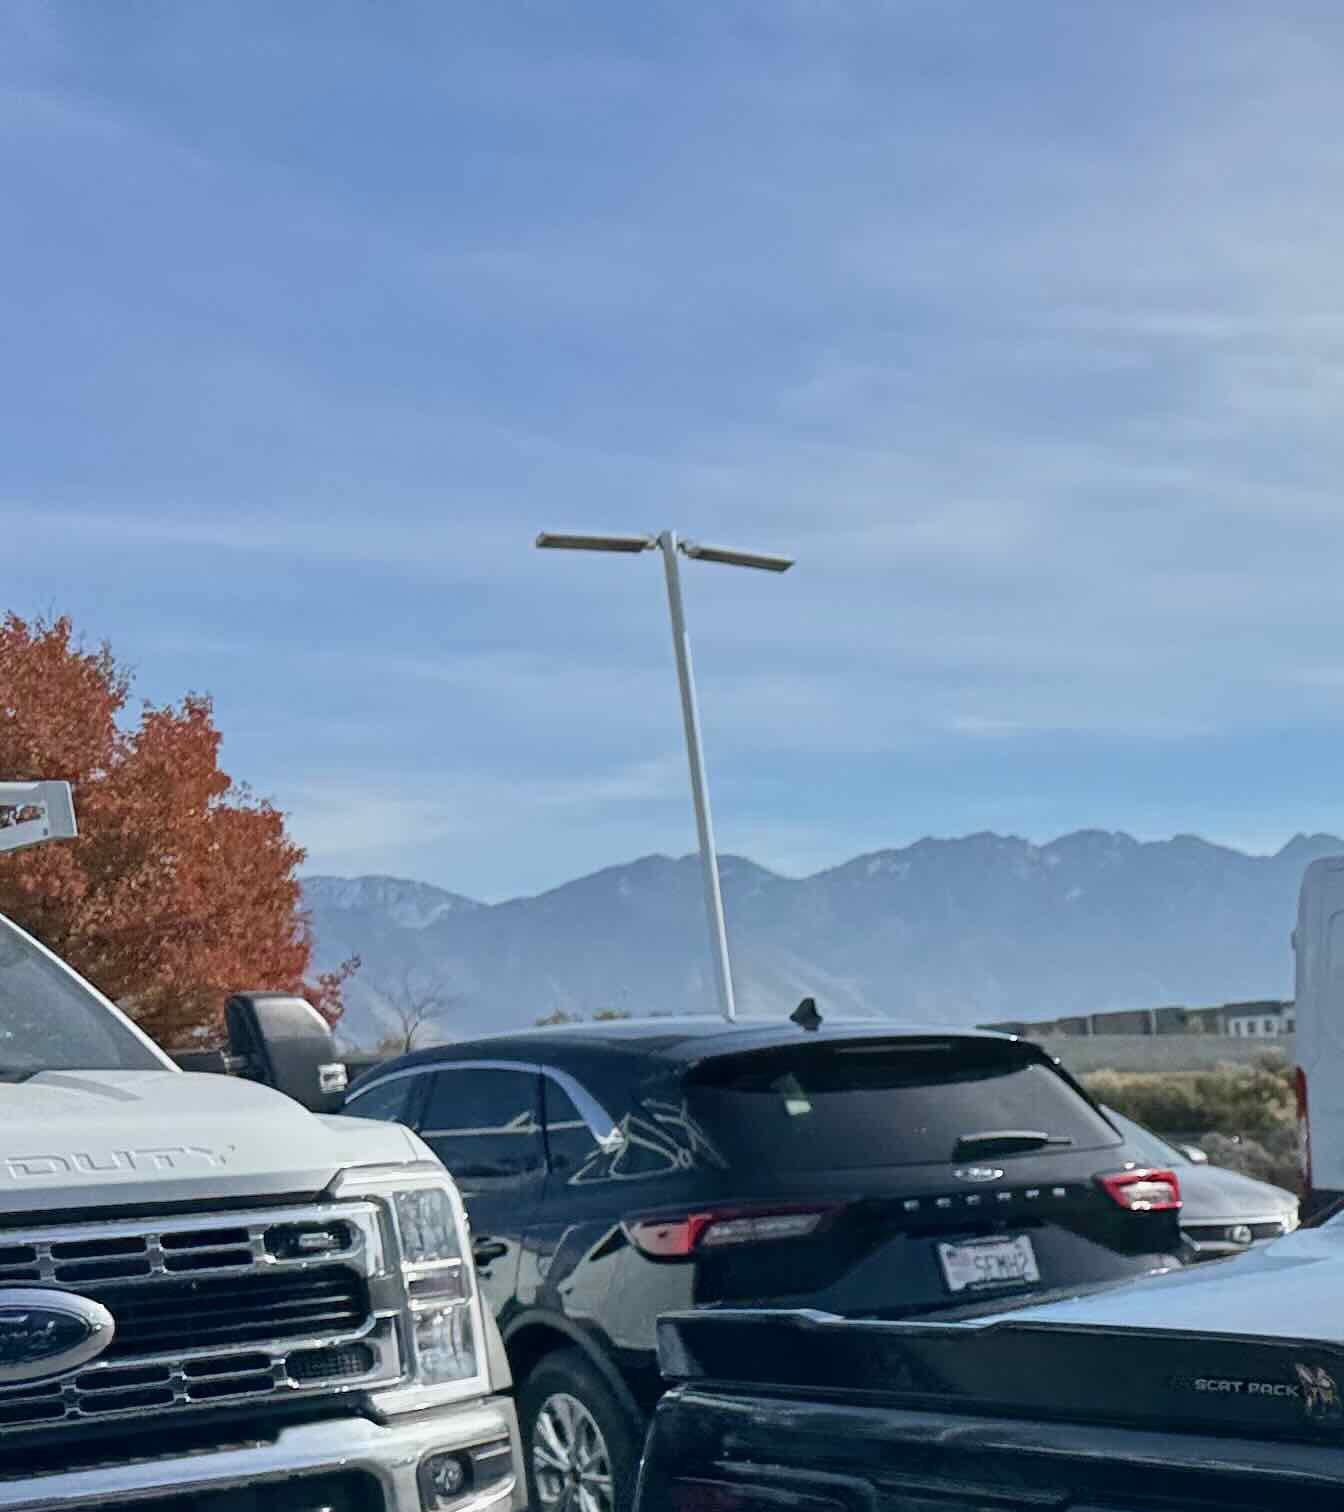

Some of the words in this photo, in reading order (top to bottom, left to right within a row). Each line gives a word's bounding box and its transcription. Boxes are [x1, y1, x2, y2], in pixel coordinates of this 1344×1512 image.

[4, 1144, 236, 1180] DUTY
[1194, 1378, 1244, 1393] SCAT
[1248, 1381, 1300, 1397] PACK
